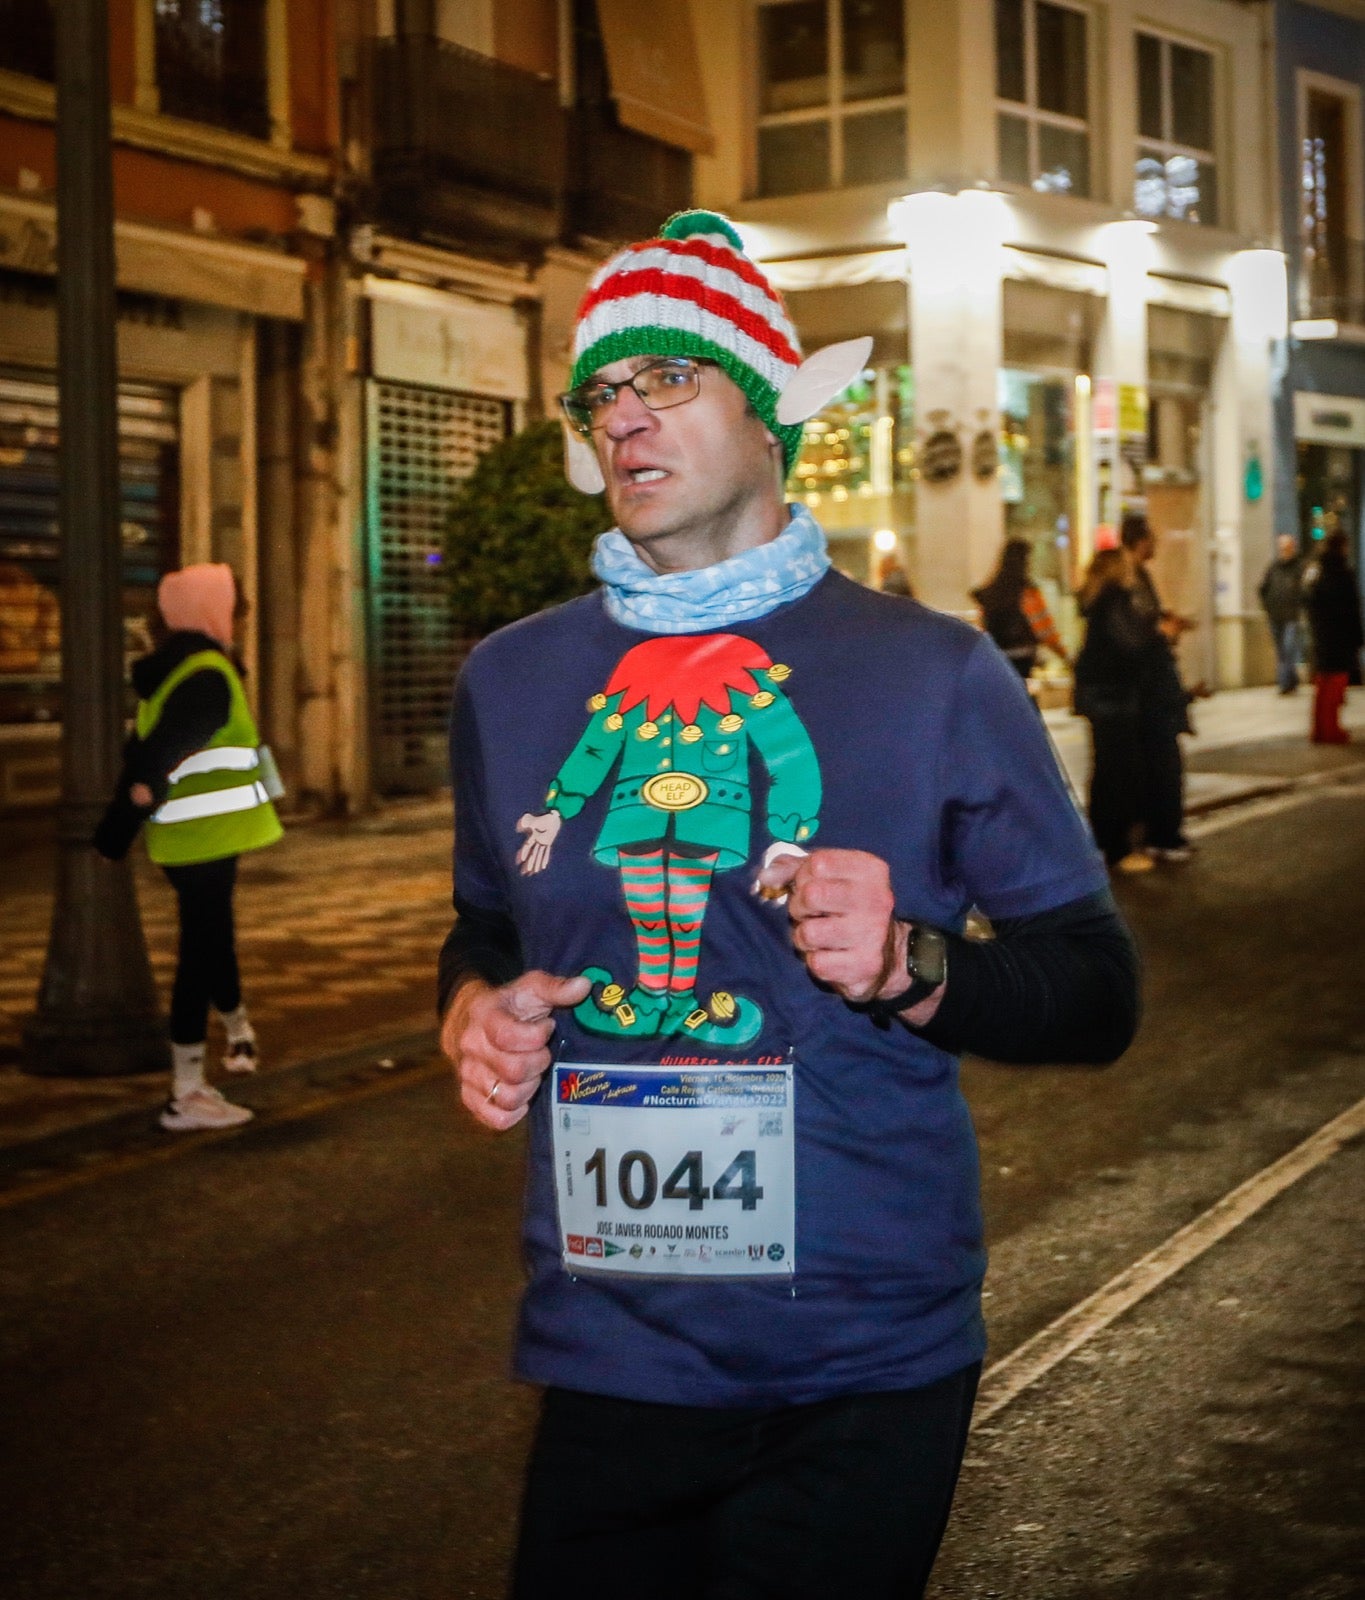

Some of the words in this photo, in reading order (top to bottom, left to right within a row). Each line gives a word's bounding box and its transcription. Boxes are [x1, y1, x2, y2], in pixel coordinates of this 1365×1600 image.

[659, 782, 690, 791] HEAD
[665, 791, 684, 799] ELF
[570, 1082, 610, 1101] Nocturna
[661, 1086, 679, 1094] Calle
[681, 1086, 705, 1096] Reyes
[584, 1147, 764, 1211] 1044
[596, 1221, 613, 1236] JOSE
[615, 1222, 642, 1238] JAVIER
[643, 1224, 683, 1239] RODADO
[685, 1225, 729, 1240] MONTES
